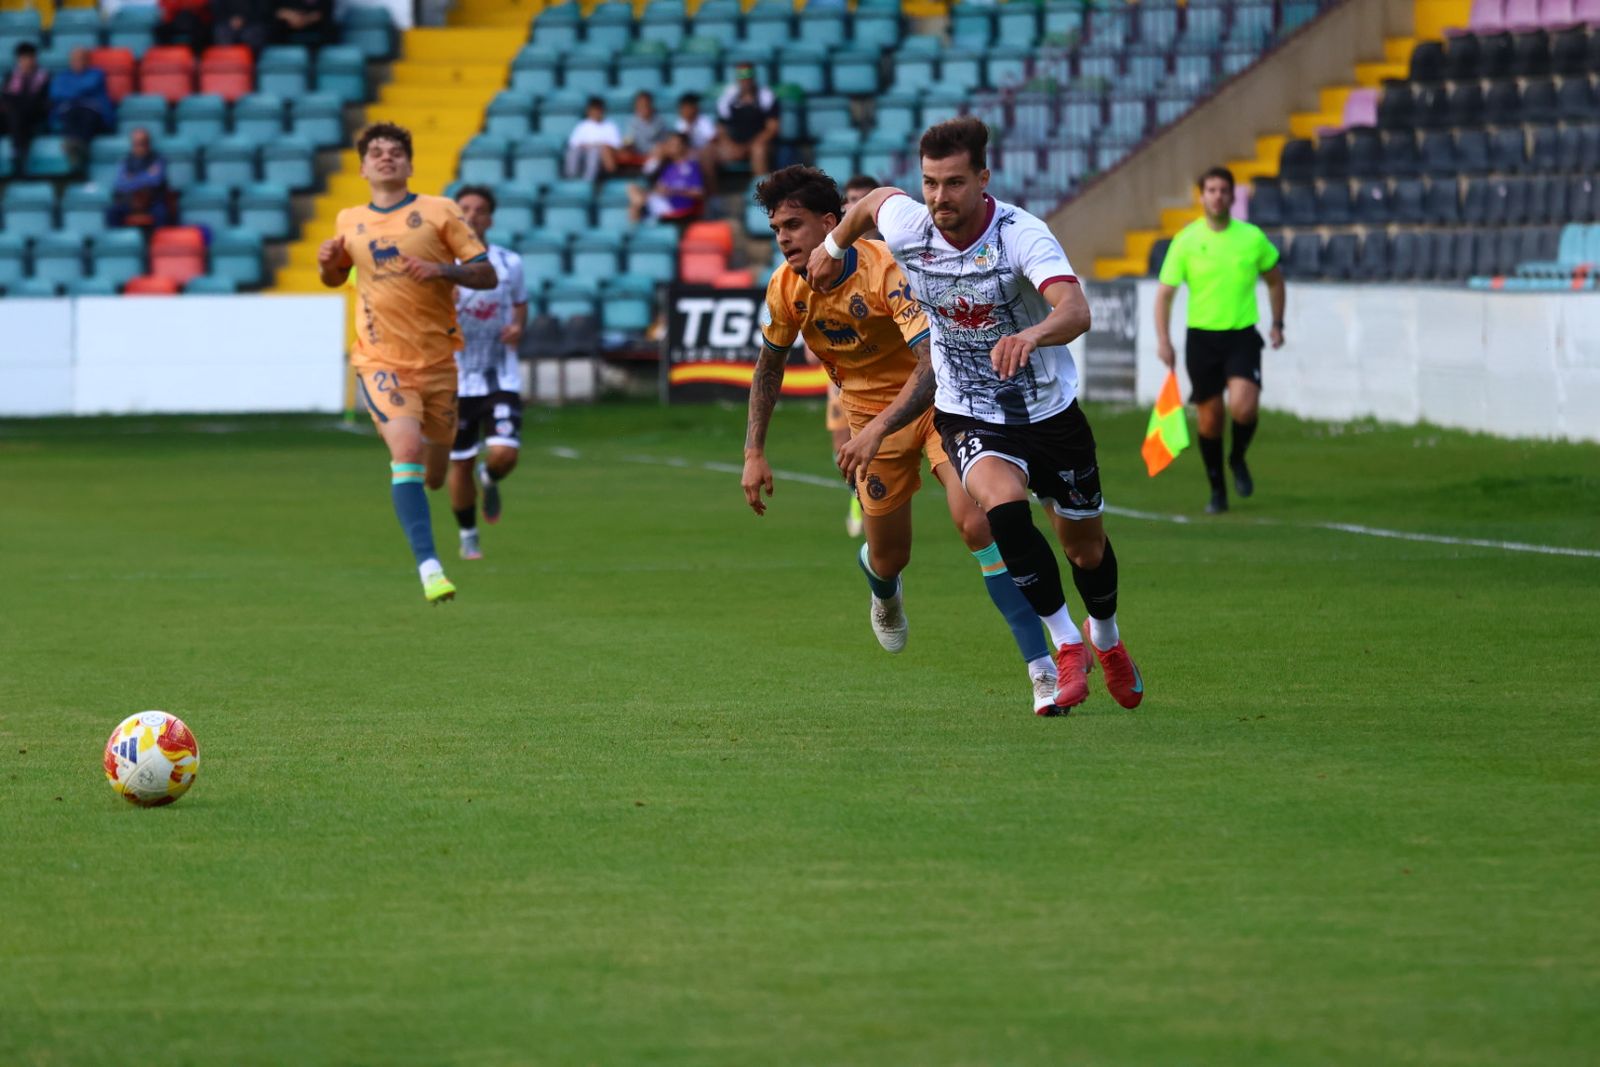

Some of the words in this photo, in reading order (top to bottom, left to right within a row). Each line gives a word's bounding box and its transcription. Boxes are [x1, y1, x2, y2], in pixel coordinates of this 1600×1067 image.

[938, 320, 1018, 341] ALAMANCA
[373, 371, 400, 392] 21
[957, 437, 983, 471] 23
